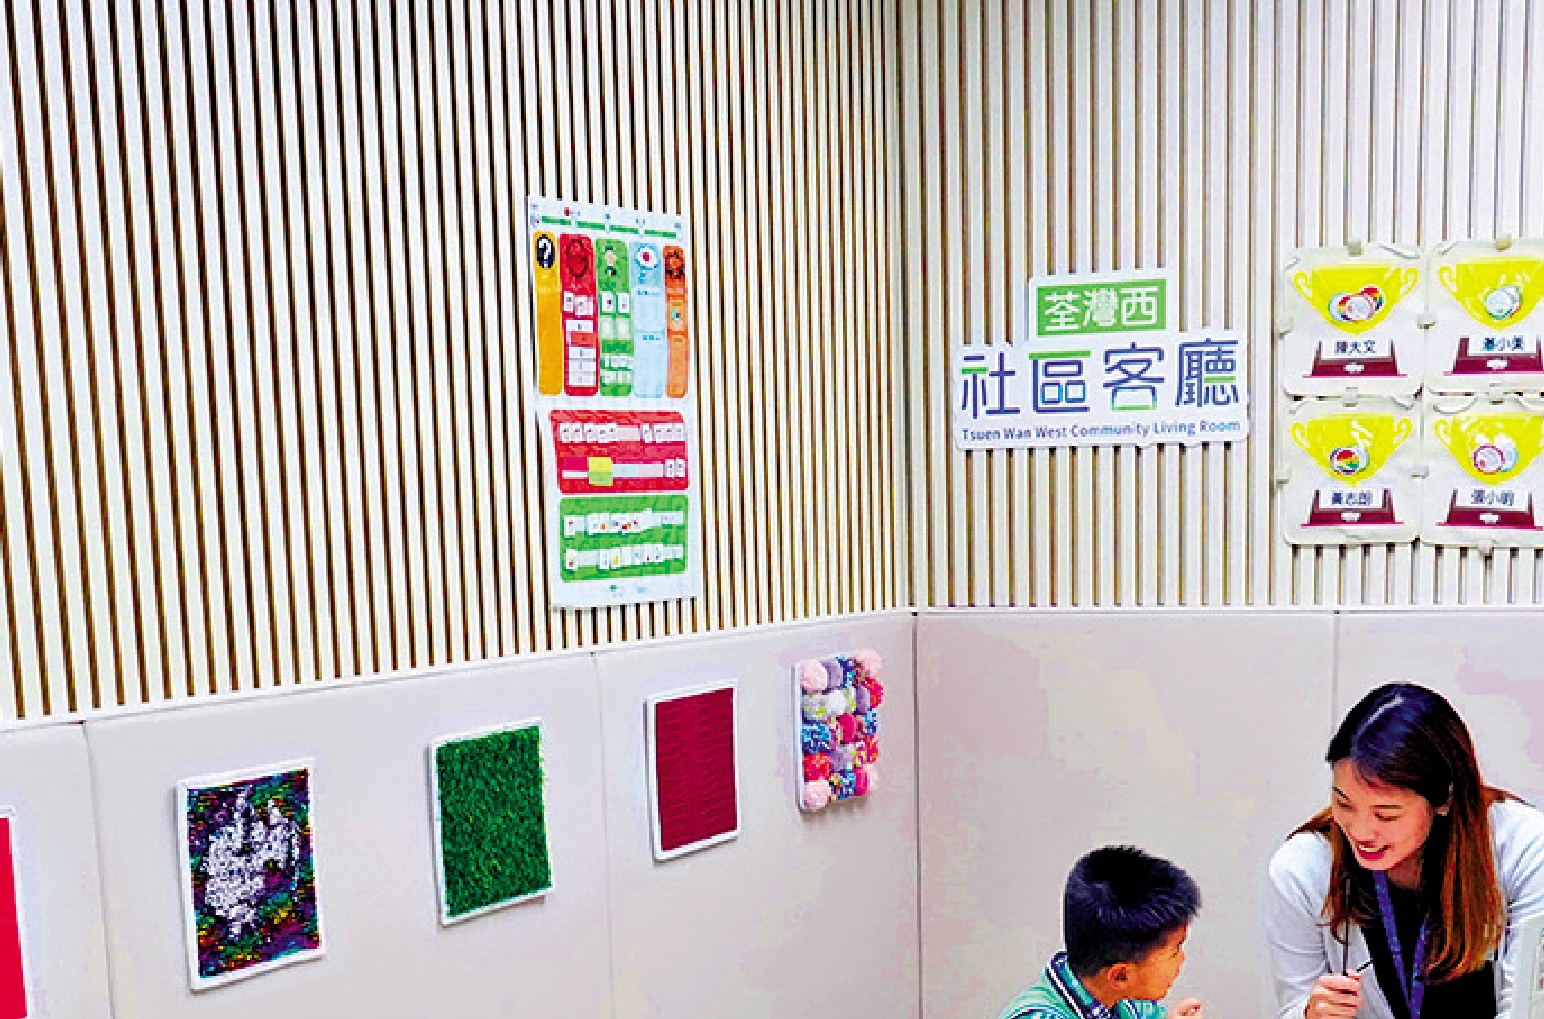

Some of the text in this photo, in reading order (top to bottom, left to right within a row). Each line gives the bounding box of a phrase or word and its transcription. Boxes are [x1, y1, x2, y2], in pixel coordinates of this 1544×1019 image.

[1044, 285, 1159, 332] 荃灣西
[960, 337, 1240, 420] 社區客廳
[961, 420, 1240, 441] Tsuen Wan West Community Living Room
